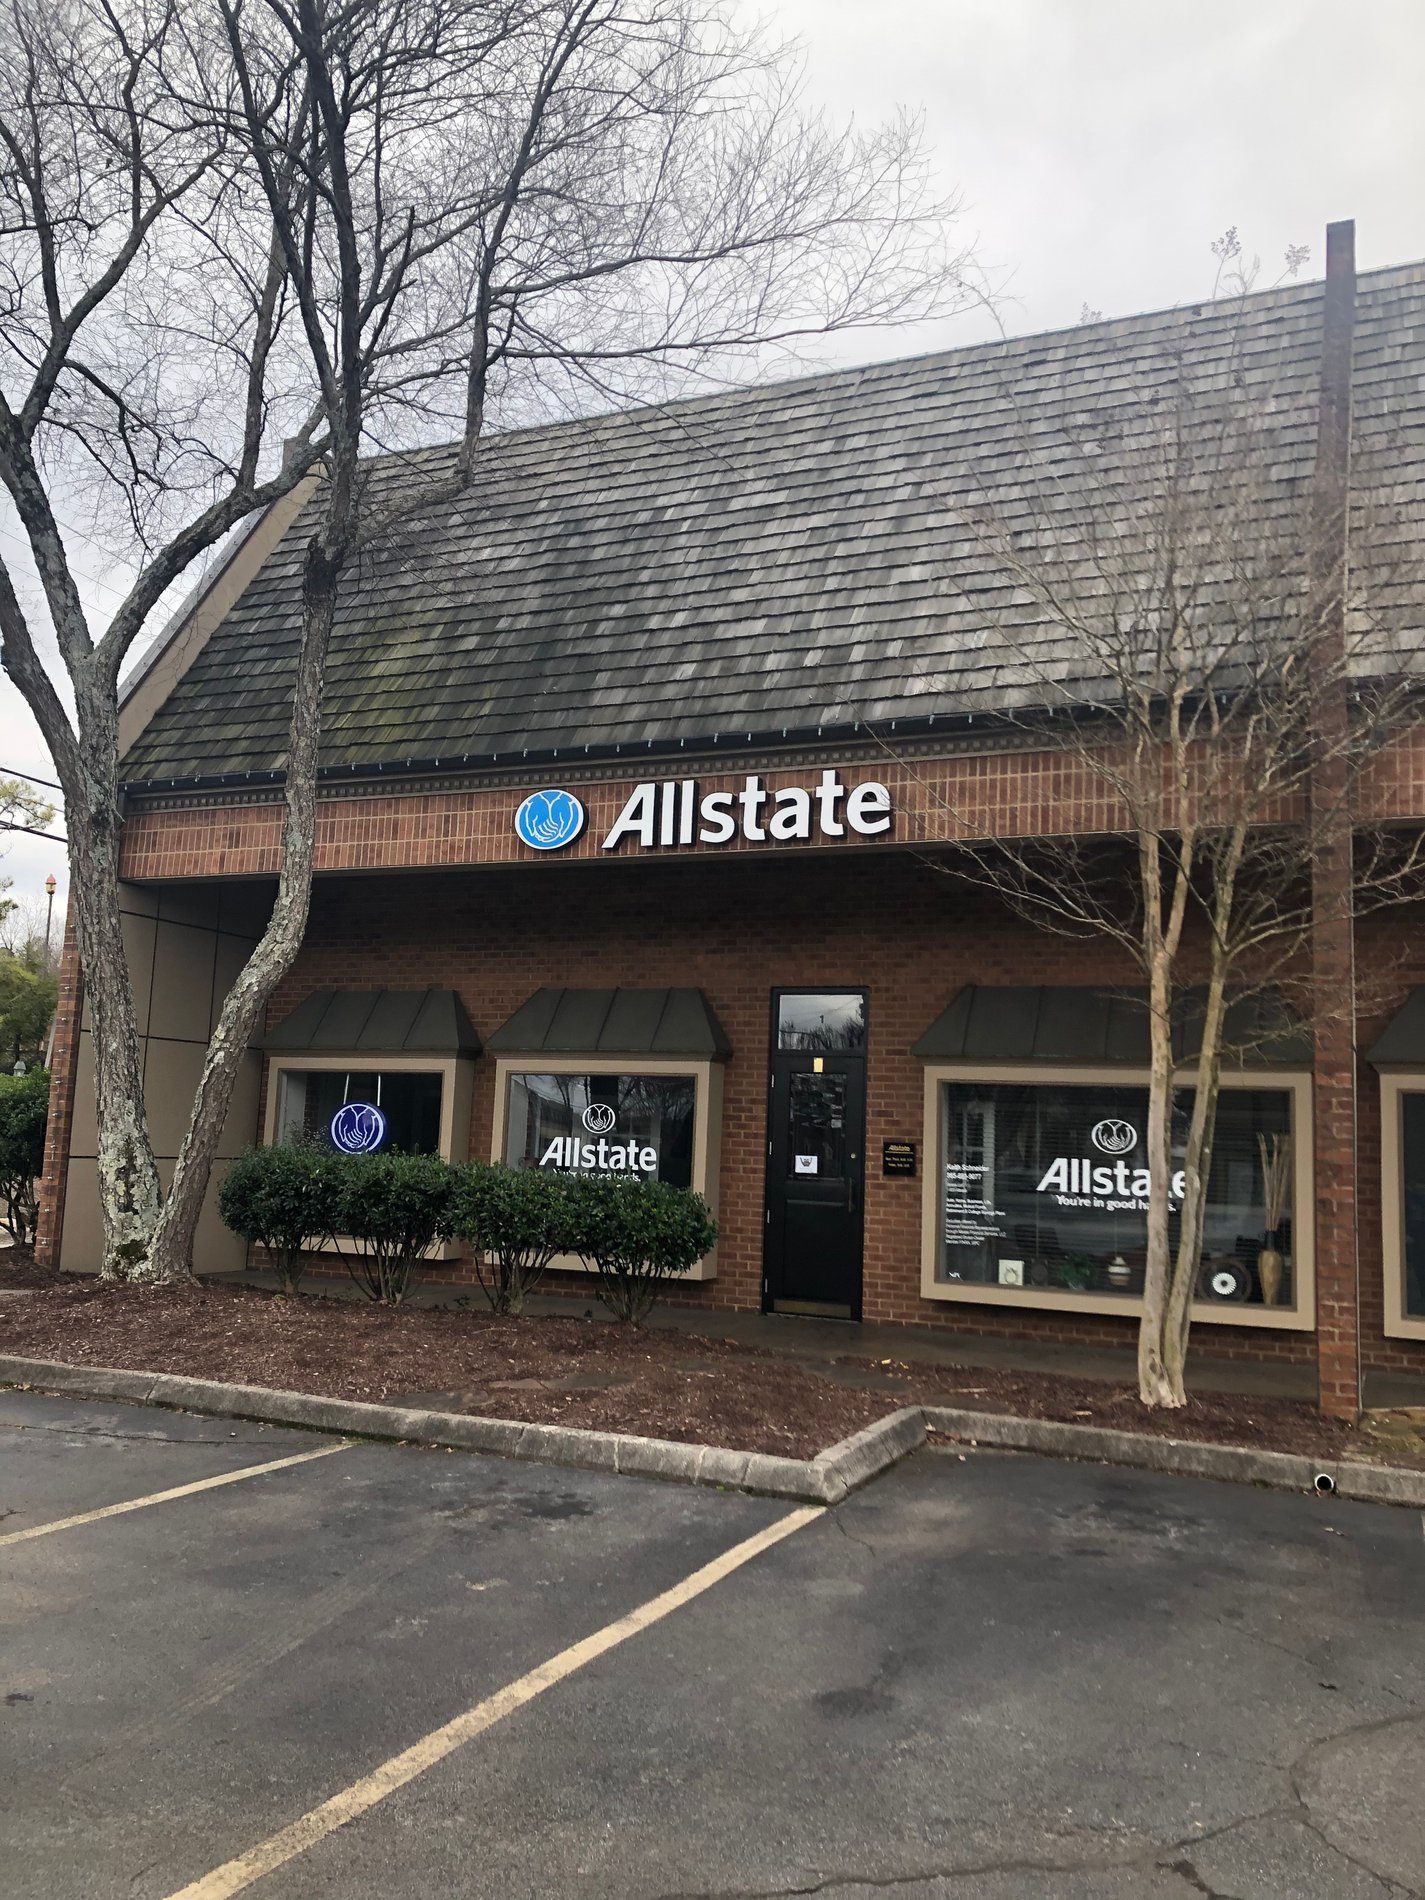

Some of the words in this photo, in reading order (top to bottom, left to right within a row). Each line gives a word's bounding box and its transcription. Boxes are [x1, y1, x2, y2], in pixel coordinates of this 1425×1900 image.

[602, 770, 891, 849] Allstate
[539, 1136, 657, 1171] Allstate
[1036, 1157, 1188, 1199] Allstae
[1056, 1195, 1091, 1207] You're
[1093, 1197, 1104, 1208] in
[1106, 1199, 1136, 1211] good
[1138, 1199, 1176, 1212] has.
